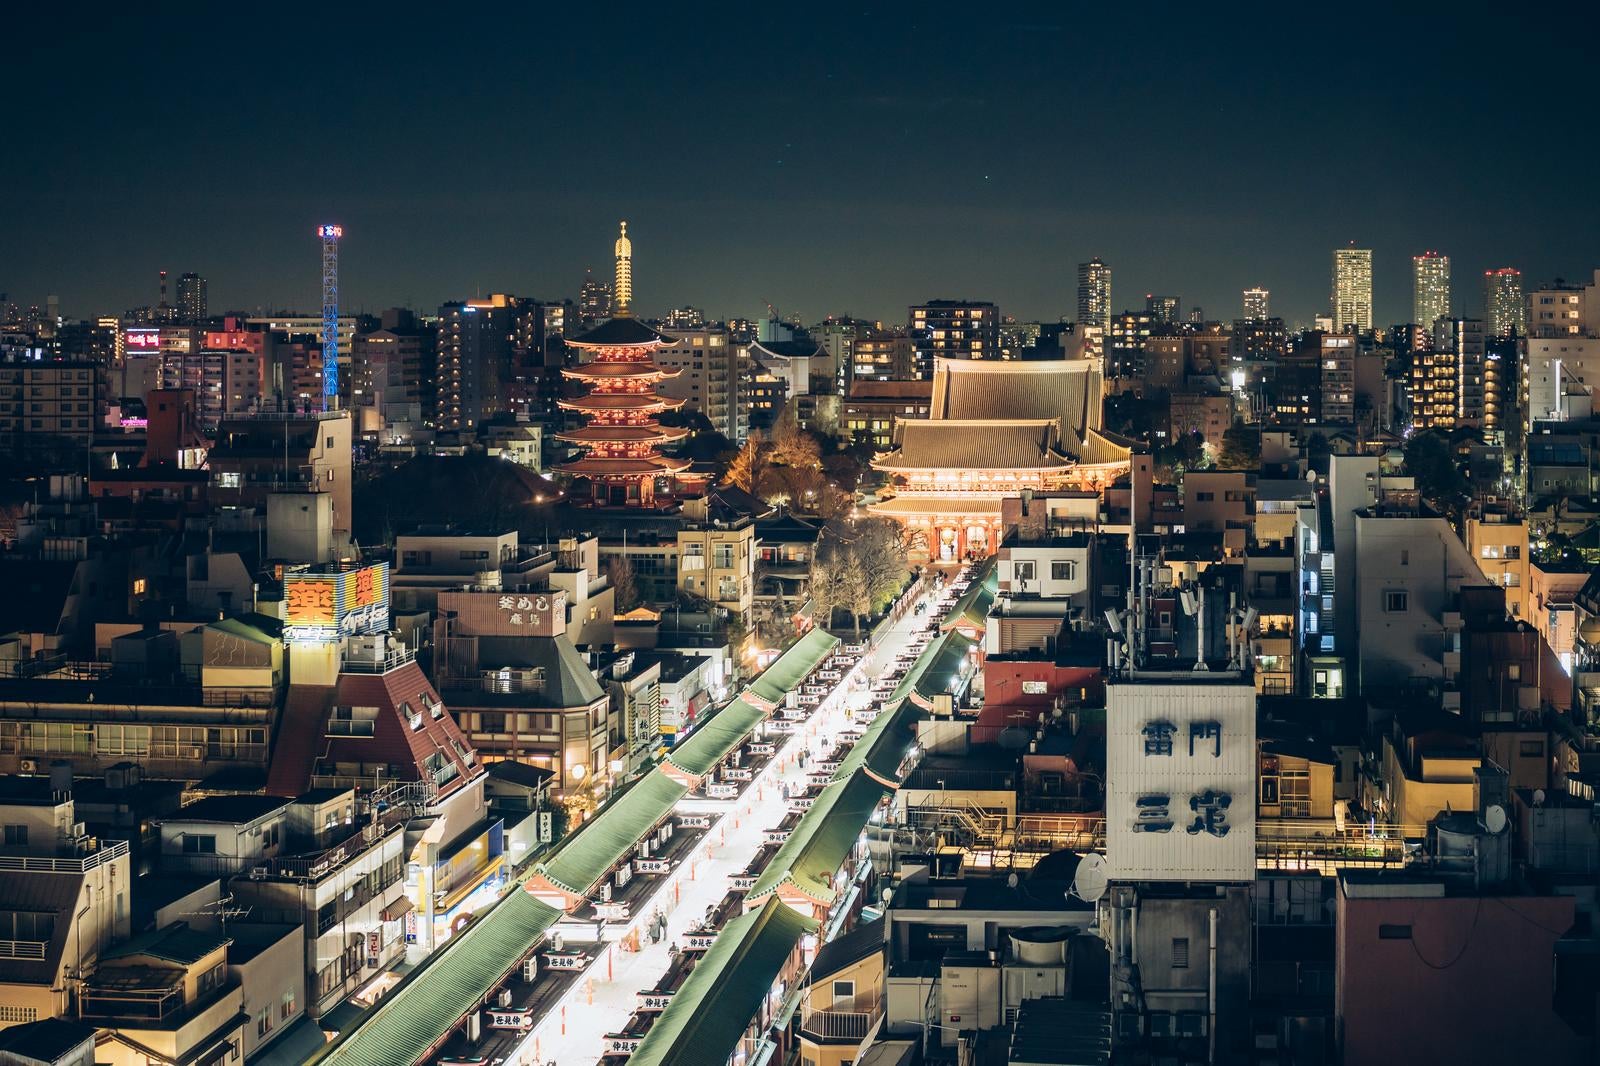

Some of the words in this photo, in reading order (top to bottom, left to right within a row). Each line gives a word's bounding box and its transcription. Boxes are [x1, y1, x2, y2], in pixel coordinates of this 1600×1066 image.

[288, 580, 334, 622] 薬
[355, 566, 375, 606] 薬
[498, 595, 550, 611] 釜めし
[1141, 720, 1222, 758] 雷門
[1132, 790, 1232, 837] 三定
